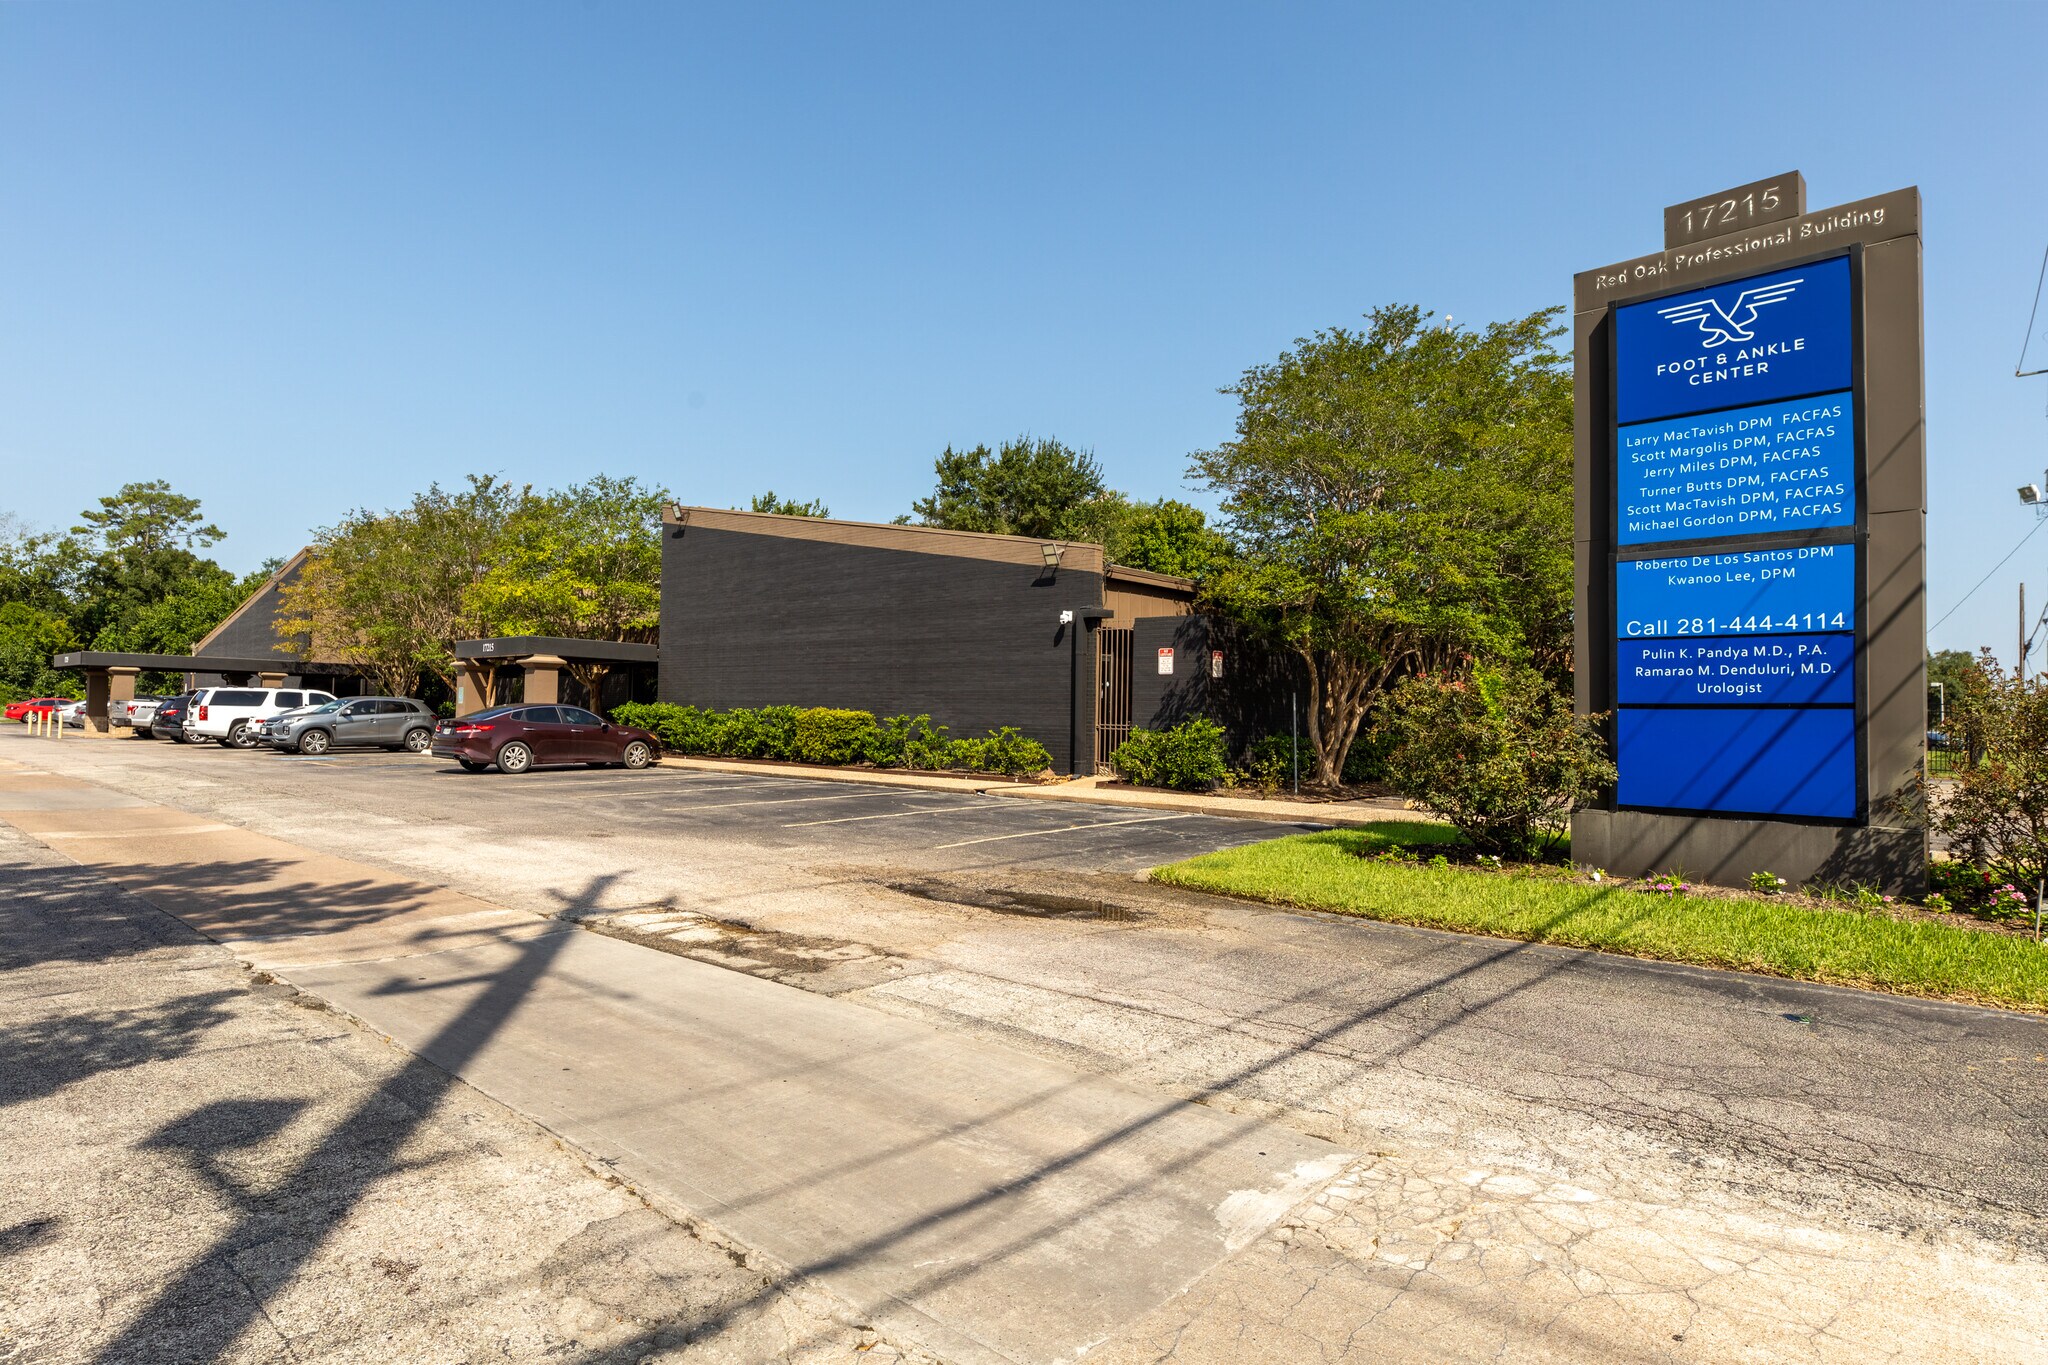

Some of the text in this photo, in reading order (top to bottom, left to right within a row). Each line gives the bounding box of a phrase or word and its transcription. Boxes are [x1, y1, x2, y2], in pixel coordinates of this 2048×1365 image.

[1680, 186, 1780, 234] 17215
[1596, 207, 1886, 290] Red Oak Professional Building
[1657, 337, 1806, 376] FOOT & ANKLE
[1689, 361, 1769, 386] CENTER
[1626, 405, 1842, 448] Larry MacTavish DPM FACFAS
[1631, 425, 1835, 463] Scott Margolis DPM, FACFAS
[1643, 445, 1821, 479] Jerry Miles DPM, FACFAS
[1639, 466, 1829, 498] Turner Butts DPM, FACFAS
[1627, 483, 1845, 516] Scott MacTavish DPM, FACFAS
[1629, 502, 1842, 532] Michael Gordon DPM, FACFAS
[1635, 546, 1834, 571] Roberto De Los Santos DPM
[1668, 567, 1796, 586] Kwanoo Lee, DPM
[1626, 612, 1845, 636] Call 281-444-4114
[1642, 644, 1827, 661] Pulin K. Pandya M.D., P.A.
[1635, 662, 1836, 677] Ramarao M. Denduluri, M.D.
[1697, 682, 1762, 697] Urologist
